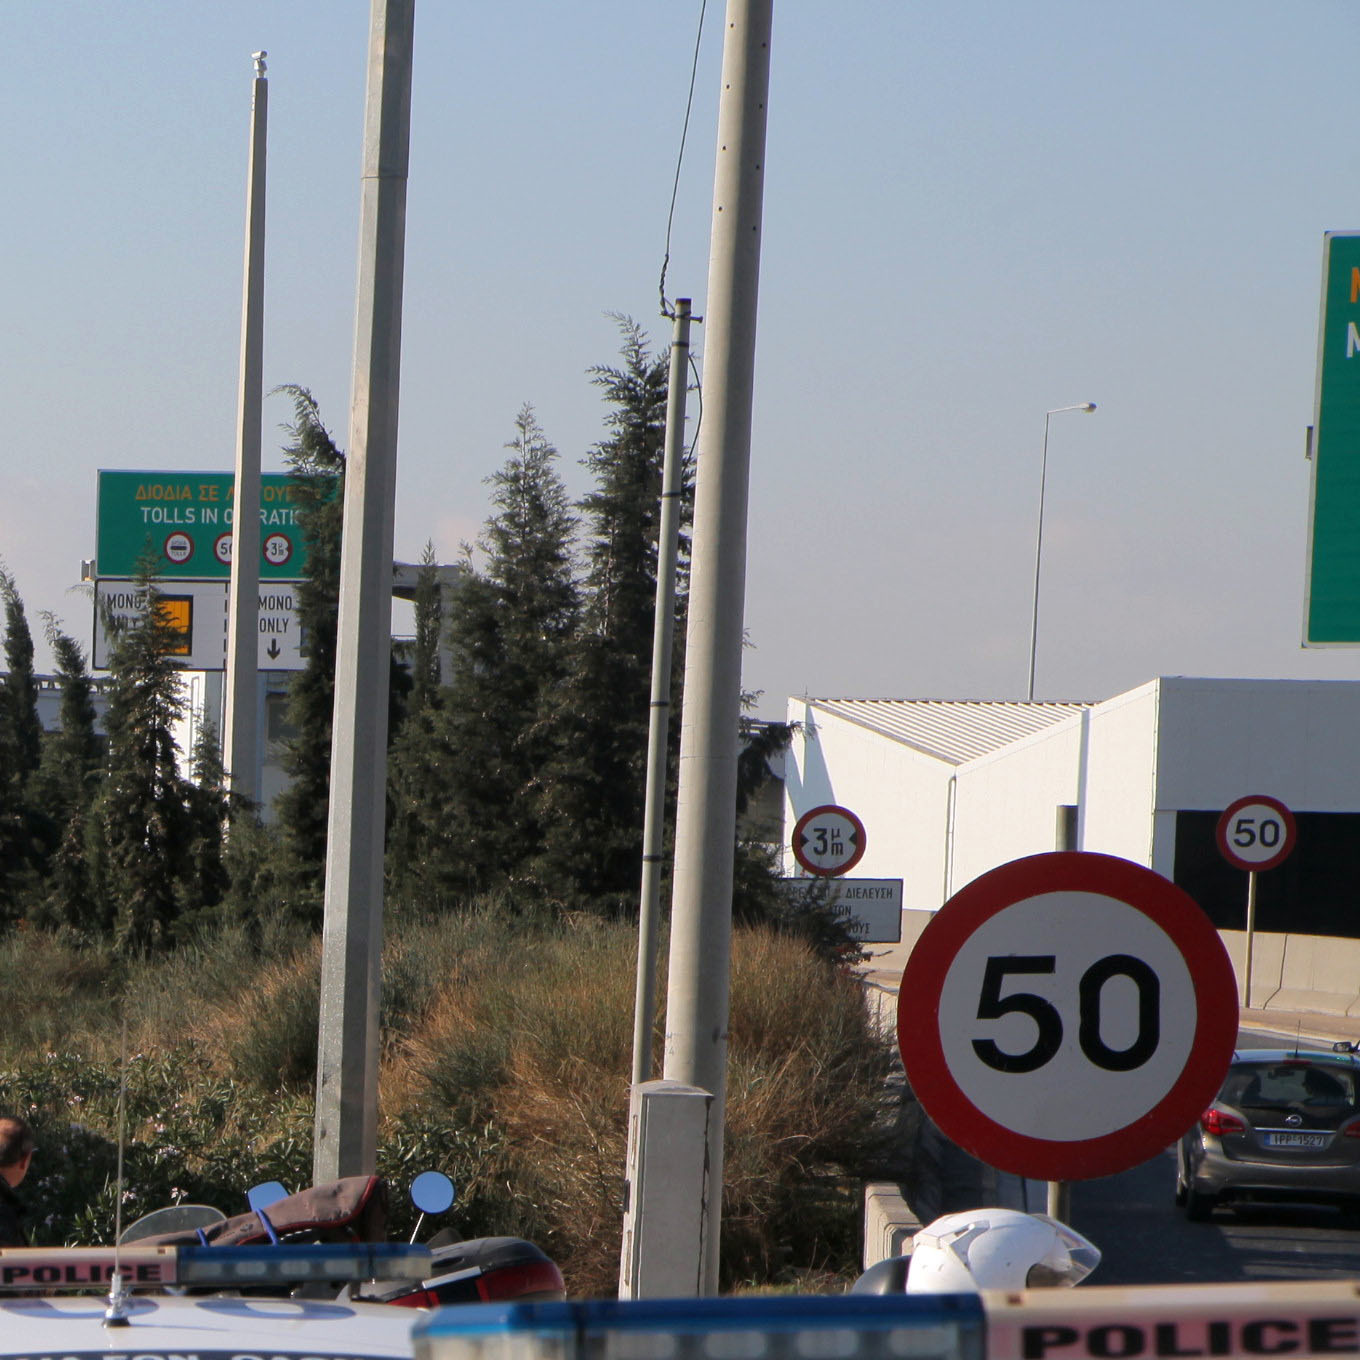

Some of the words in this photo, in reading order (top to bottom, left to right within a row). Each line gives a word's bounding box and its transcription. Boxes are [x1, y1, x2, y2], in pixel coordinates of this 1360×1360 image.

[135, 484, 192, 501] ΔΙΟΔΙΑ
[198, 485, 220, 501] ΣΕ
[141, 507, 195, 524] TOLLS
[201, 508, 218, 524] IN
[259, 595, 293, 611] ΜΟΝΟ
[260, 618, 289, 634] ONLY
[813, 827, 828, 856] 3
[1233, 818, 1281, 849] 50
[845, 886, 893, 900] ΔΙΕΛΕΥΣΗ
[970, 953, 1162, 1074] 50
[2, 1264, 162, 1286] POLICE
[1021, 1316, 1360, 1360] POLICE
